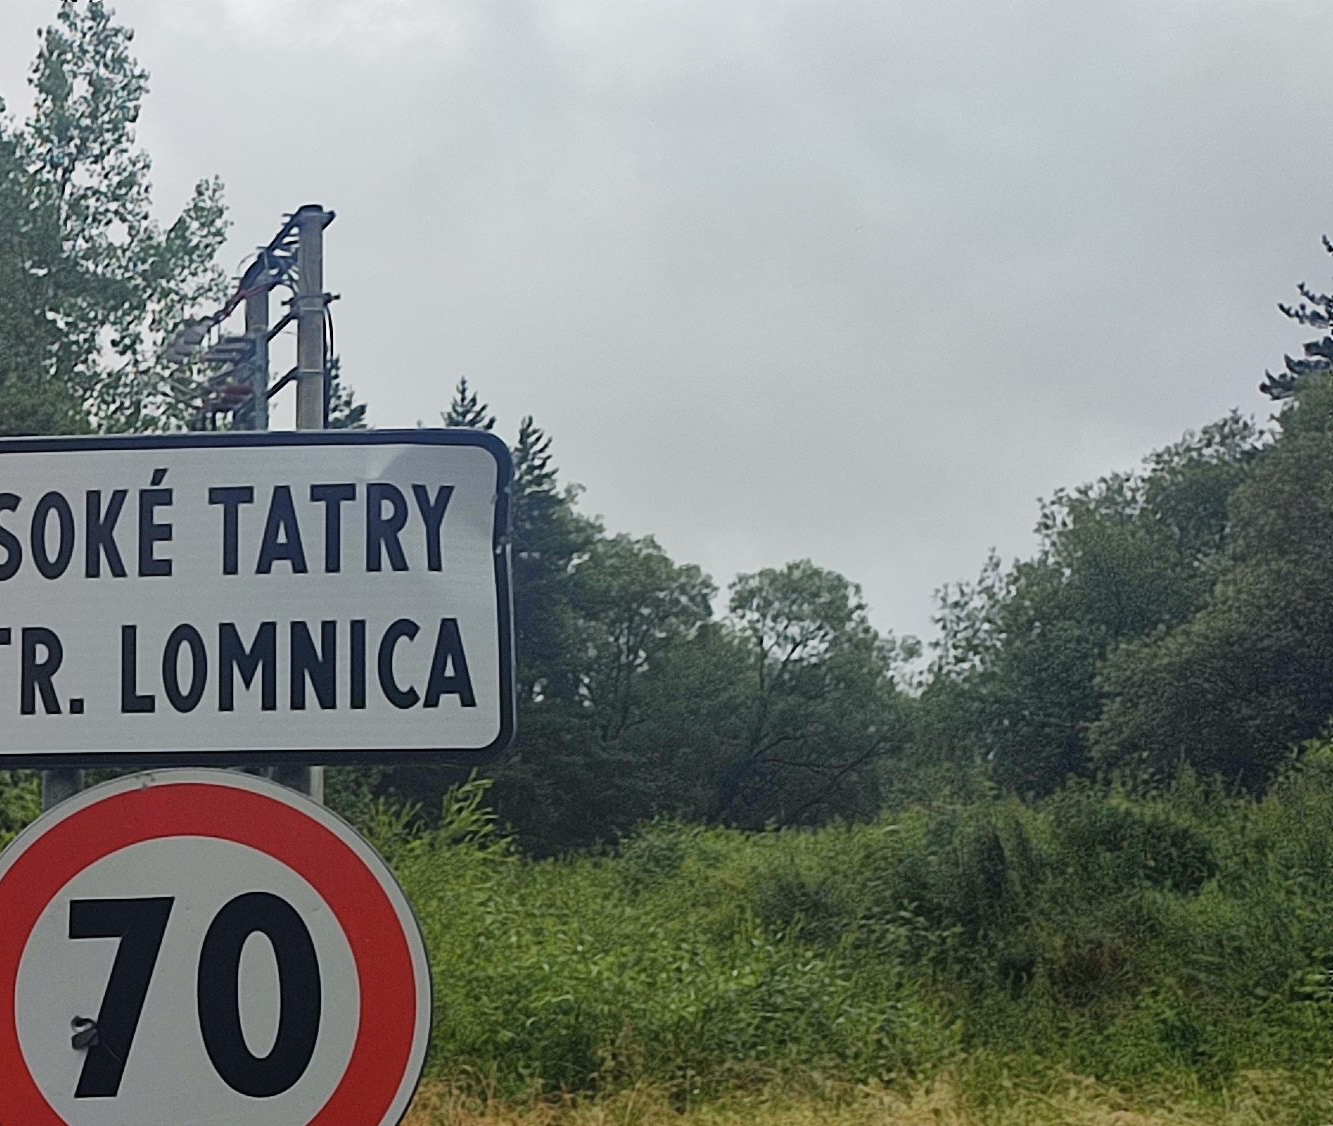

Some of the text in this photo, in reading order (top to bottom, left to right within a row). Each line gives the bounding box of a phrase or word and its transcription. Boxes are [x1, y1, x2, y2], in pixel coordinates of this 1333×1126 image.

[207, 482, 456, 576] TATRY
[120, 617, 478, 714] LOMNICA
[68, 891, 322, 1099] 70
